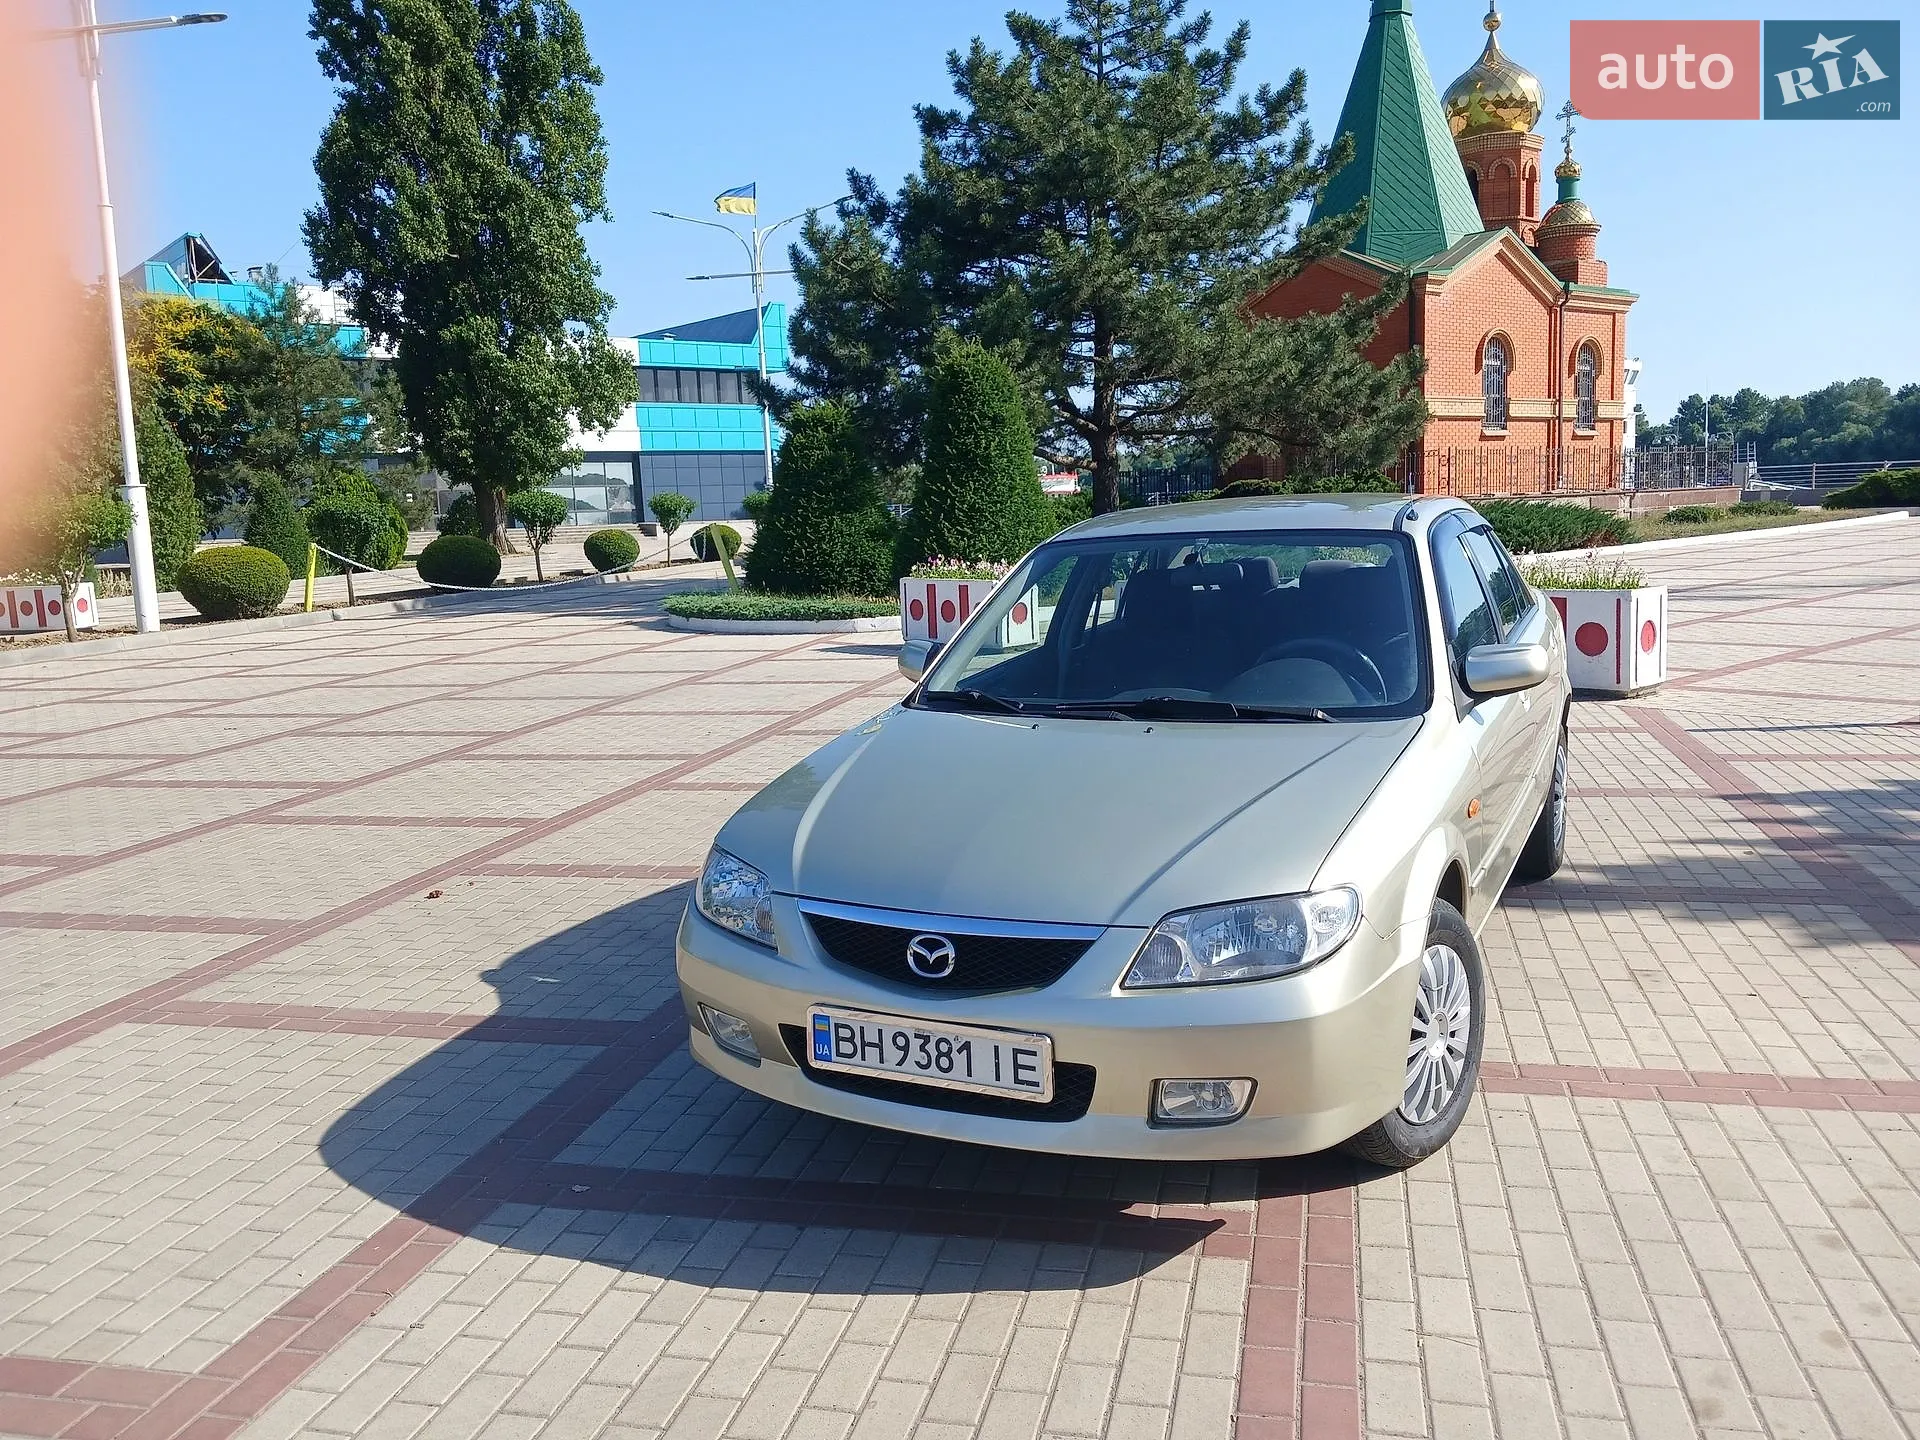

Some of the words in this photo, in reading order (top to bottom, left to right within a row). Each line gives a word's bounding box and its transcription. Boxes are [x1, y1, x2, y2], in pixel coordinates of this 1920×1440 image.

[815, 1043, 830, 1056] UA
[834, 1022, 884, 1064] BH
[891, 1031, 973, 1077] 9381
[993, 1044, 1040, 1087] IE
